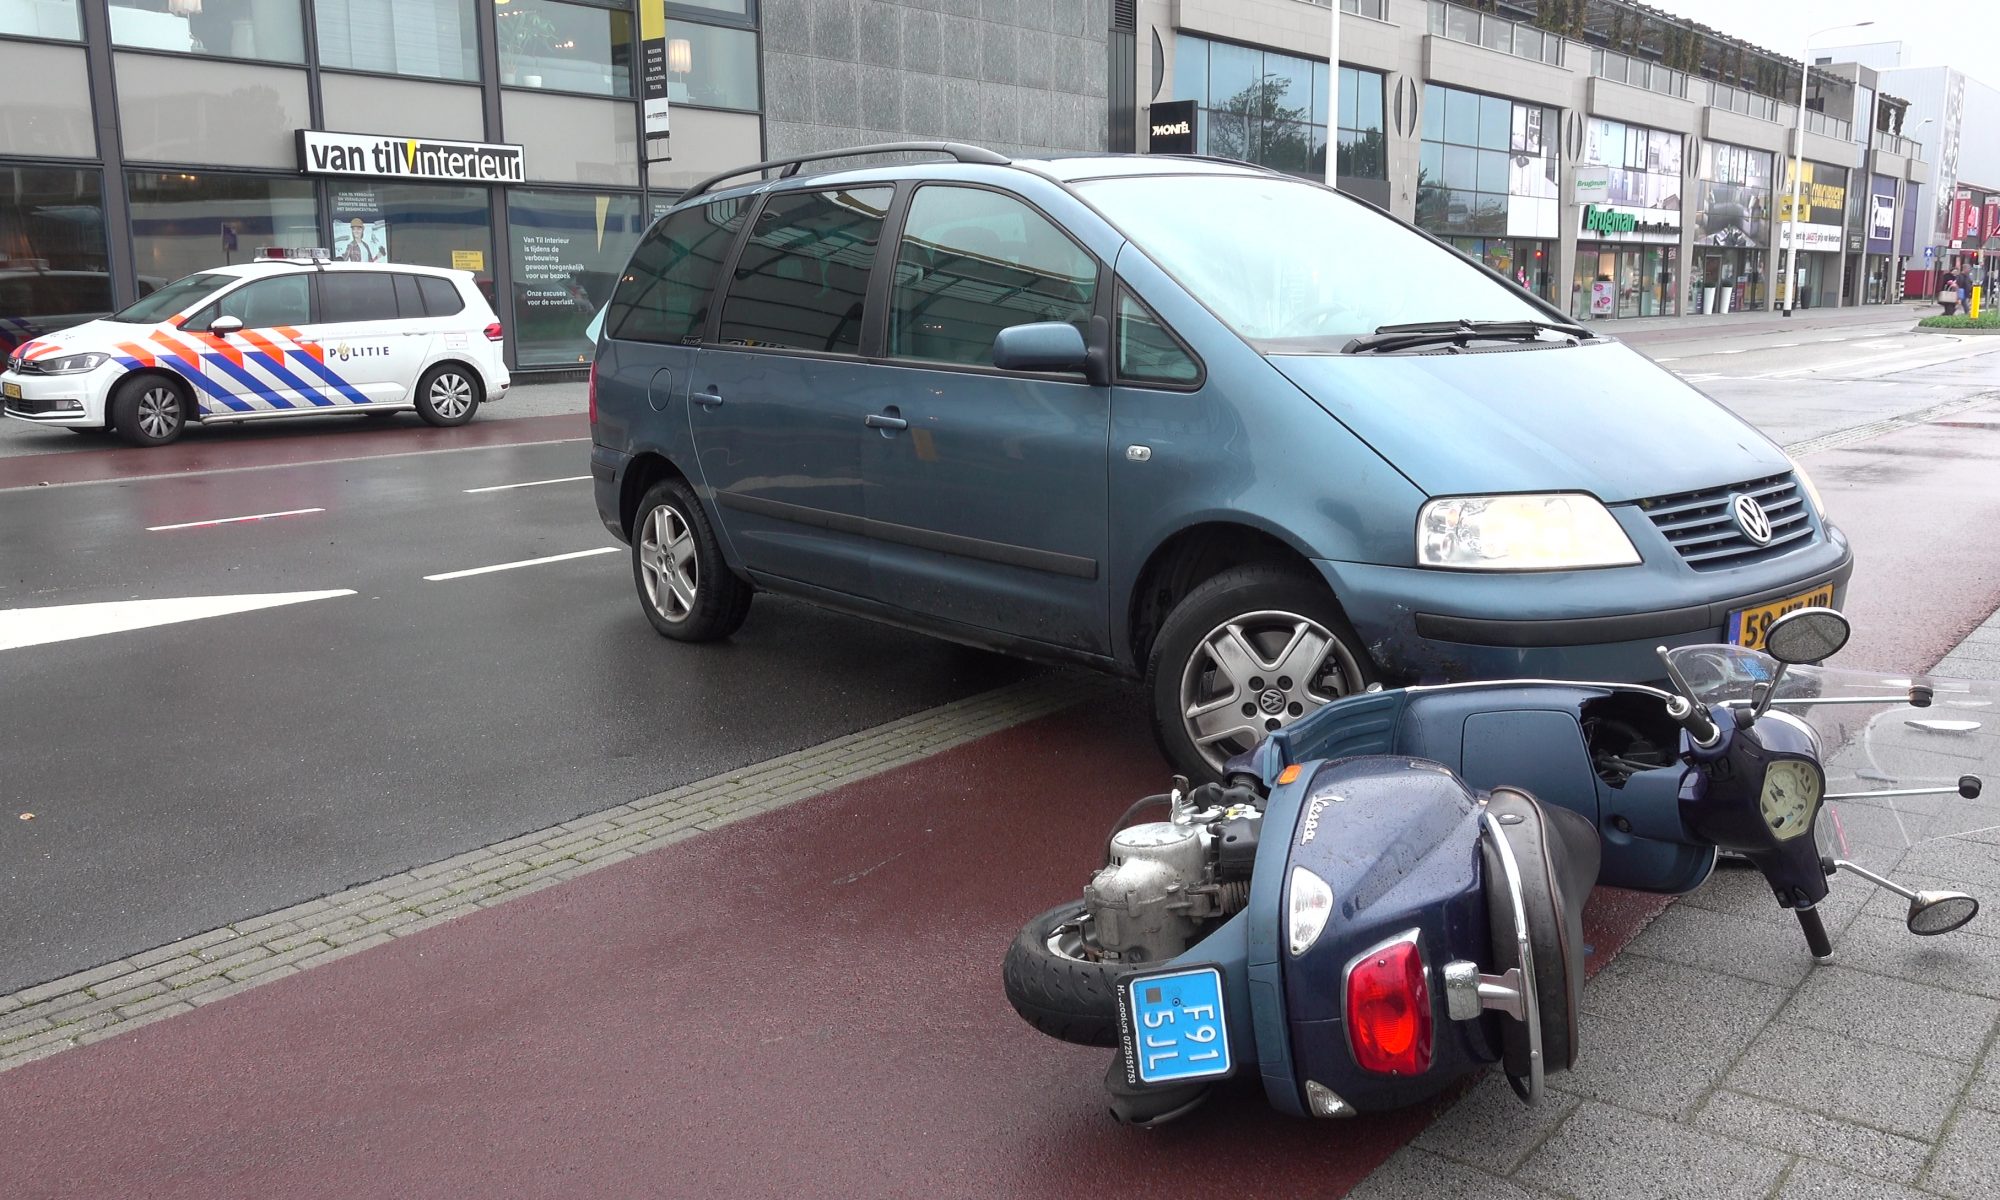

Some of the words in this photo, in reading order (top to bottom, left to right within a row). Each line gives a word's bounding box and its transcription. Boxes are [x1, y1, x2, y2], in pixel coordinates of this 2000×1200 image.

[311, 143, 366, 172] van
[371, 140, 399, 174] til
[415, 142, 521, 180] interieur
[1586, 204, 1635, 236] Brugman
[524, 255, 559, 263] verbouwing
[525, 264, 549, 272] gewoon
[549, 263, 585, 272] toegankelijk
[530, 245, 551, 254] tijdens
[329, 345, 390, 362] POLITIE
[1301, 794, 1345, 846] Vespa
[1144, 1010, 1179, 1070] 5JL
[1183, 1004, 1219, 1061] F91
[1123, 1035, 1136, 1084] 0725151753
